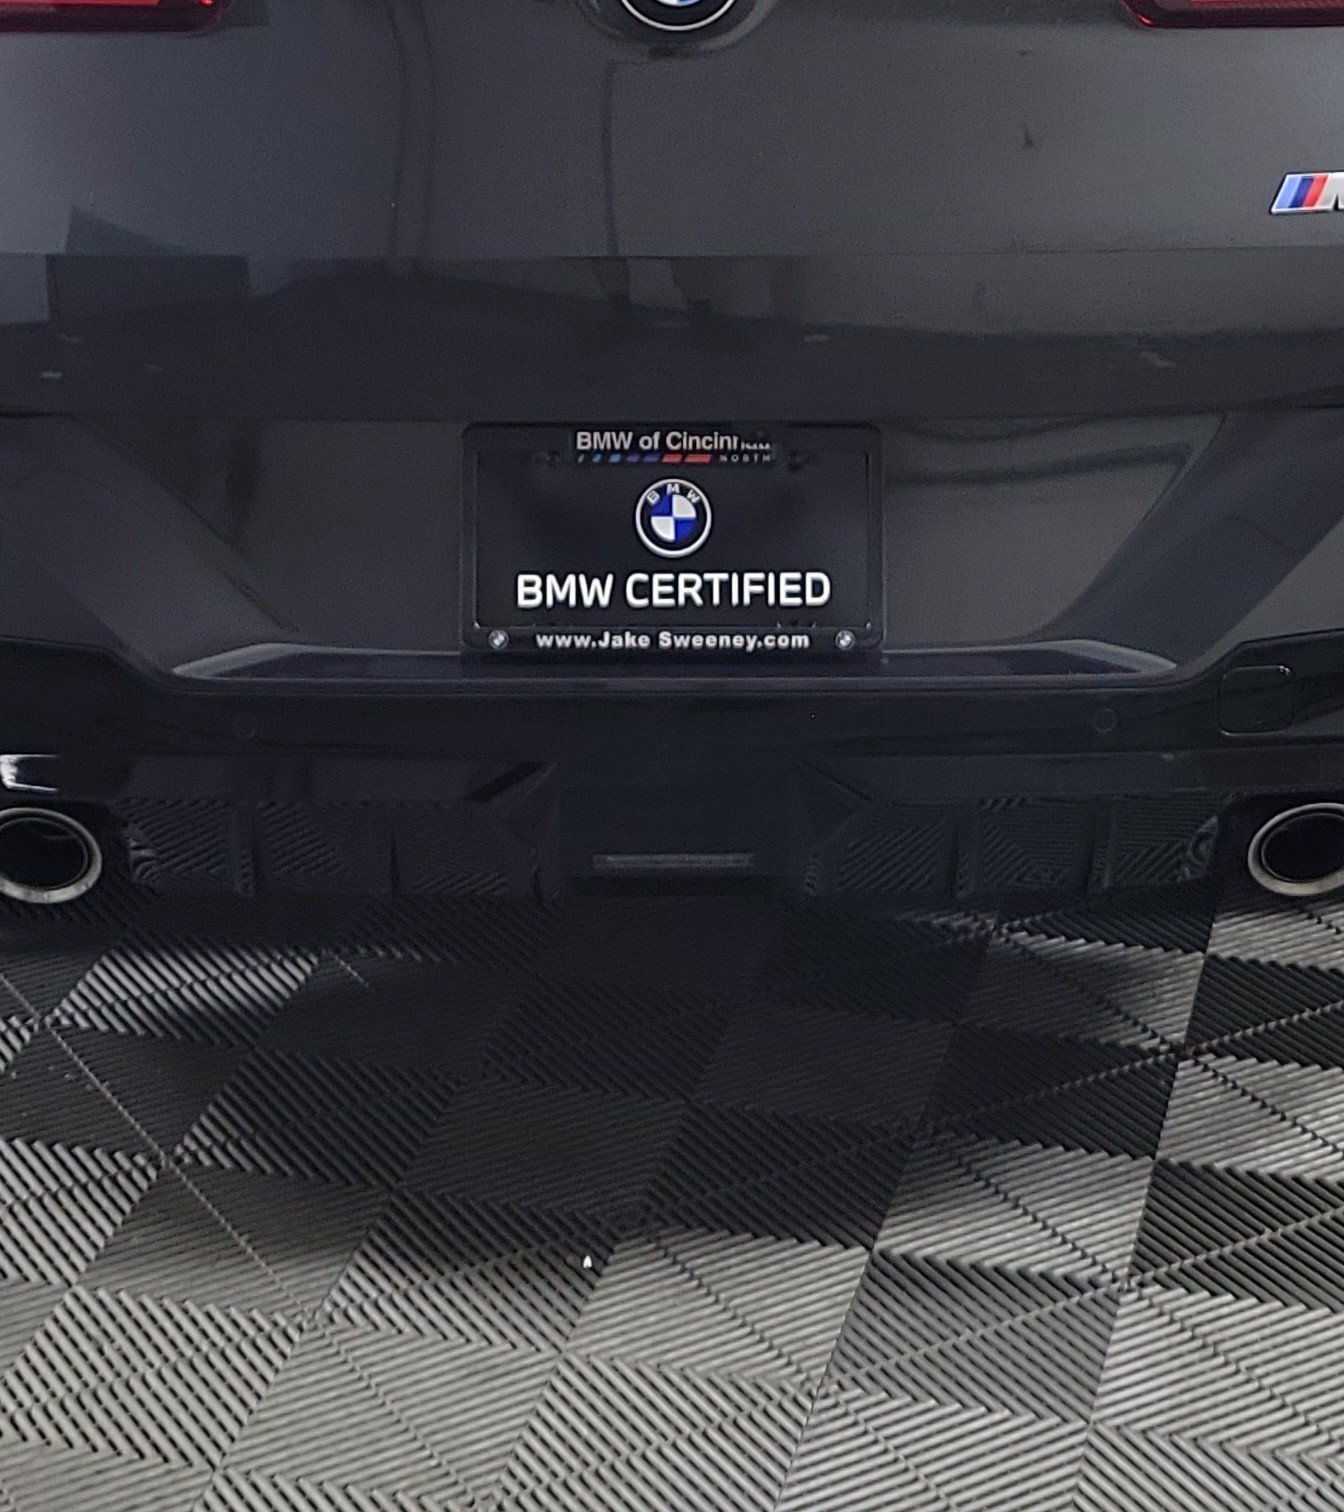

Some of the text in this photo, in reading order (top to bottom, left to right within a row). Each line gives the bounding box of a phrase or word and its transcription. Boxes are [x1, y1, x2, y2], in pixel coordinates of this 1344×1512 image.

[576, 431, 633, 450] BMW
[639, 431, 661, 450] of
[646, 483, 701, 506] BMW
[516, 571, 832, 609] BMW CERTIFIED
[535, 631, 811, 652] www.Jake Sweeney.com
